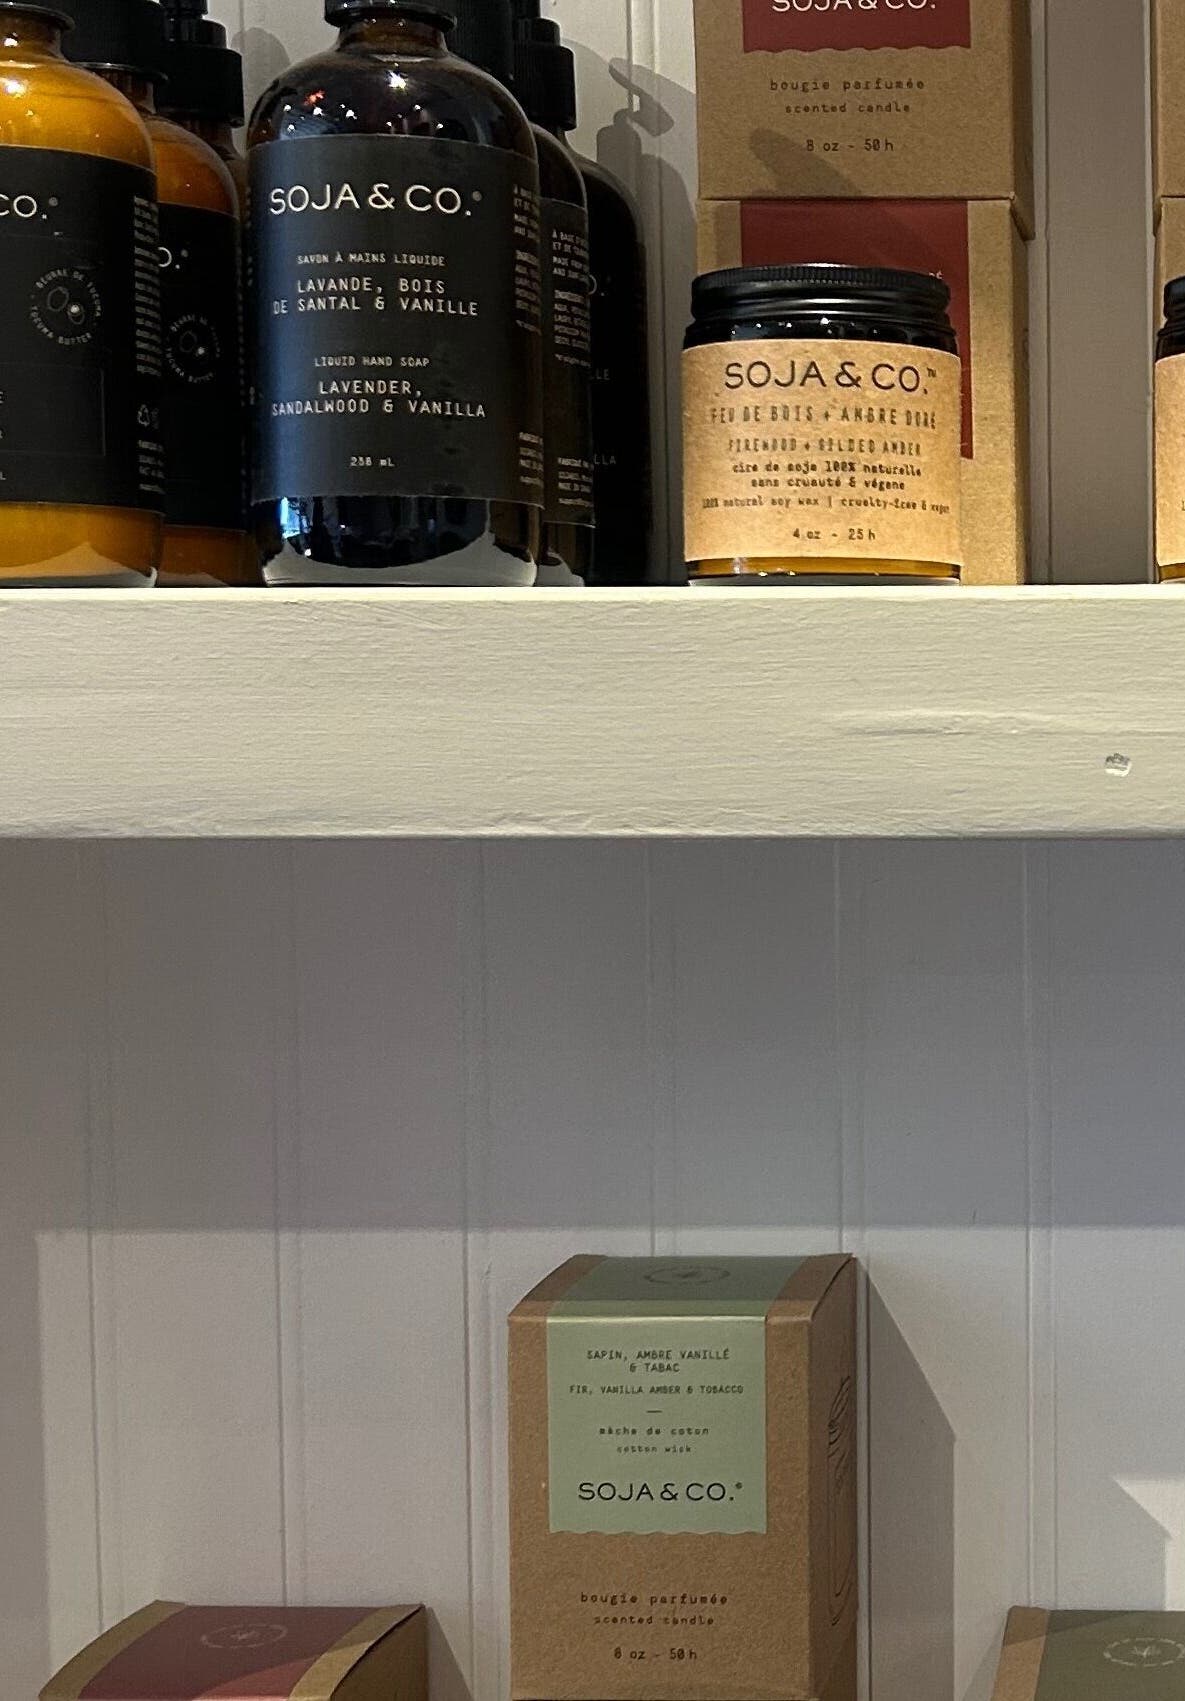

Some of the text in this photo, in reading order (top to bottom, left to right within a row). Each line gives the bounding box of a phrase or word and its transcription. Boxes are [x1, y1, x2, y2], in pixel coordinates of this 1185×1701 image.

[769, 78, 925, 91] bougie parfumée
[785, 103, 911, 114] scented candle
[806, 140, 839, 152] 8 oz
[297, 253, 446, 267] SAVON MAINS LIQUIDE
[297, 277, 445, 294] LAVANDE, BOIS
[272, 296, 479, 316] DE SANTAL & VANILLE
[314, 357, 430, 368] LIQUID HAND SOAP
[319, 380, 422, 397] LAVENDER,
[272, 399, 486, 418] SANDALWOOD & VANILLA
[771, 405, 812, 421] BOIS
[841, 407, 896, 425] AMBRE
[732, 460, 921, 476] cire de soja 100% naturelle
[752, 479, 779, 487] sans
[787, 476, 840, 488] cruauté
[798, 498, 819, 506] wax
[793, 529, 820, 540] 4 oz
[587, 1348, 730, 1362] SAPIN, AMBRE VANILLÉ
[645, 1363, 680, 1372] TABAC
[569, 1385, 743, 1394] FIR, VANILLA AMBER TOBACCO
[646, 1427, 661, 1435] de
[665, 1445, 691, 1453] wick
[581, 1592, 728, 1606] bougie parfumée
[594, 1616, 714, 1625] scented candle
[630, 1651, 646, 1660] oz
